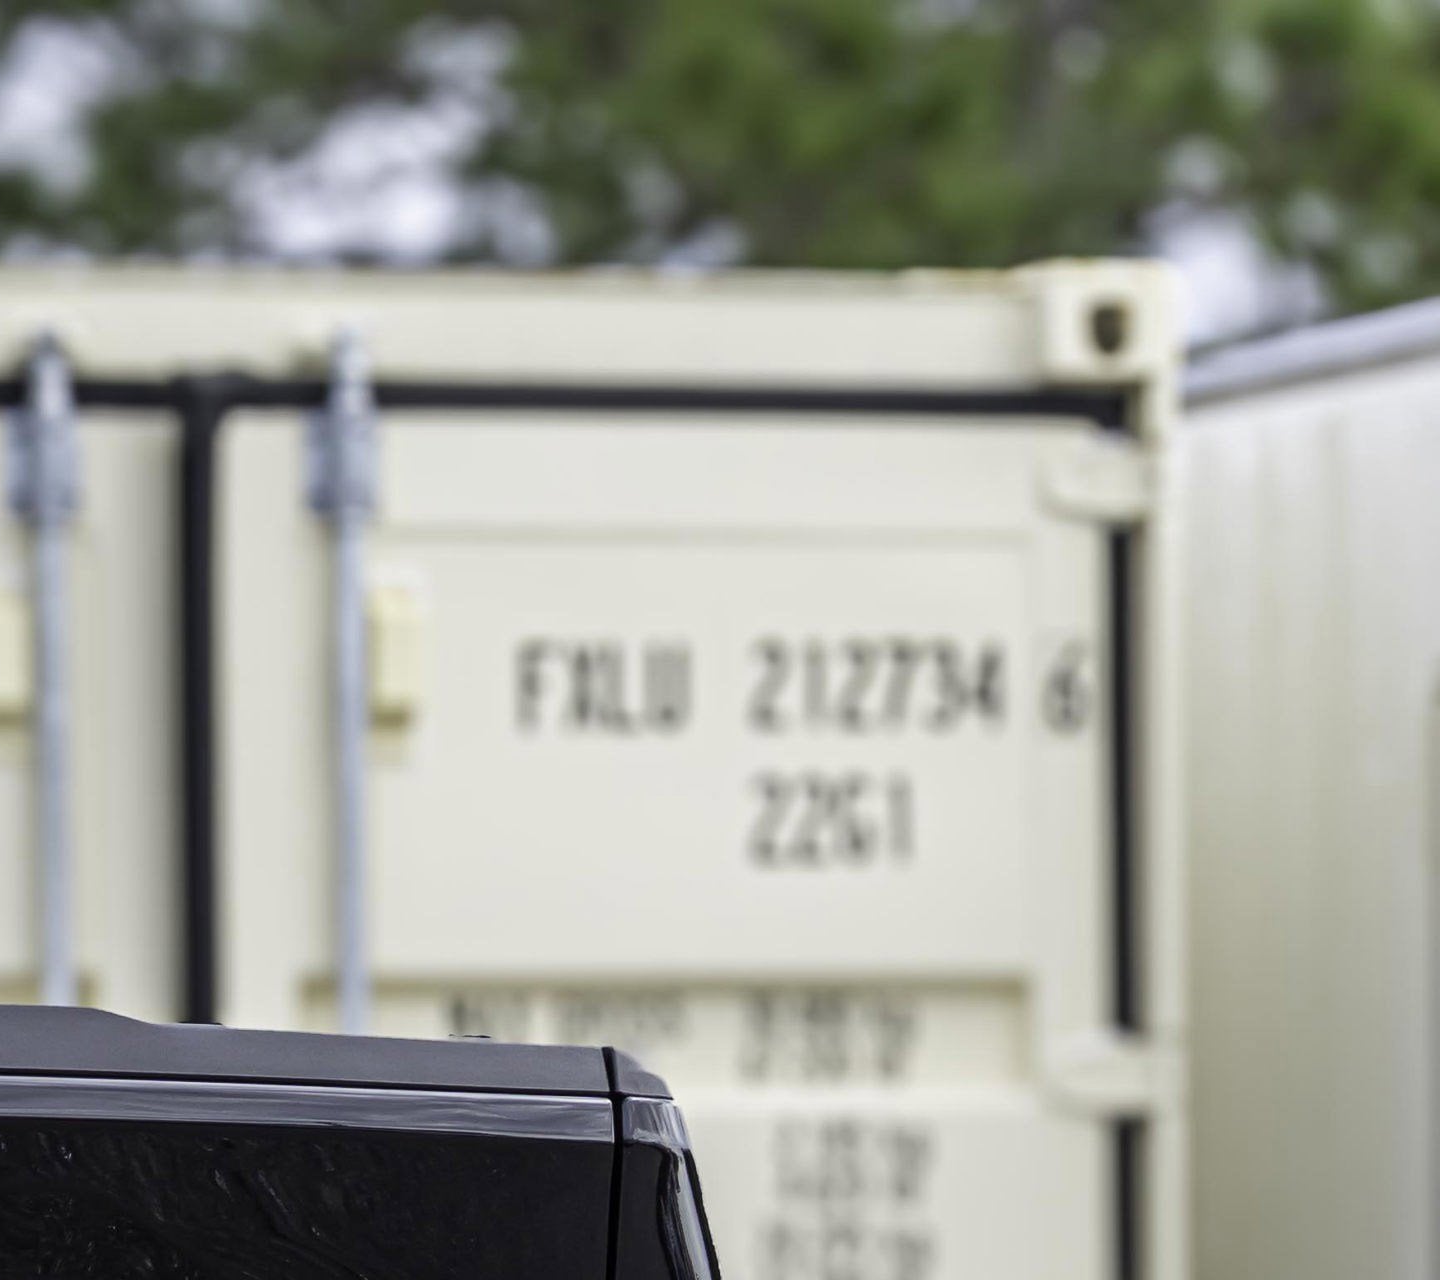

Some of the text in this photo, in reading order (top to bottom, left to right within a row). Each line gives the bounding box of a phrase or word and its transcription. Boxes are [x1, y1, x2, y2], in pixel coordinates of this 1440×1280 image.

[512, 638, 1093, 739] FXLU 212734 6
